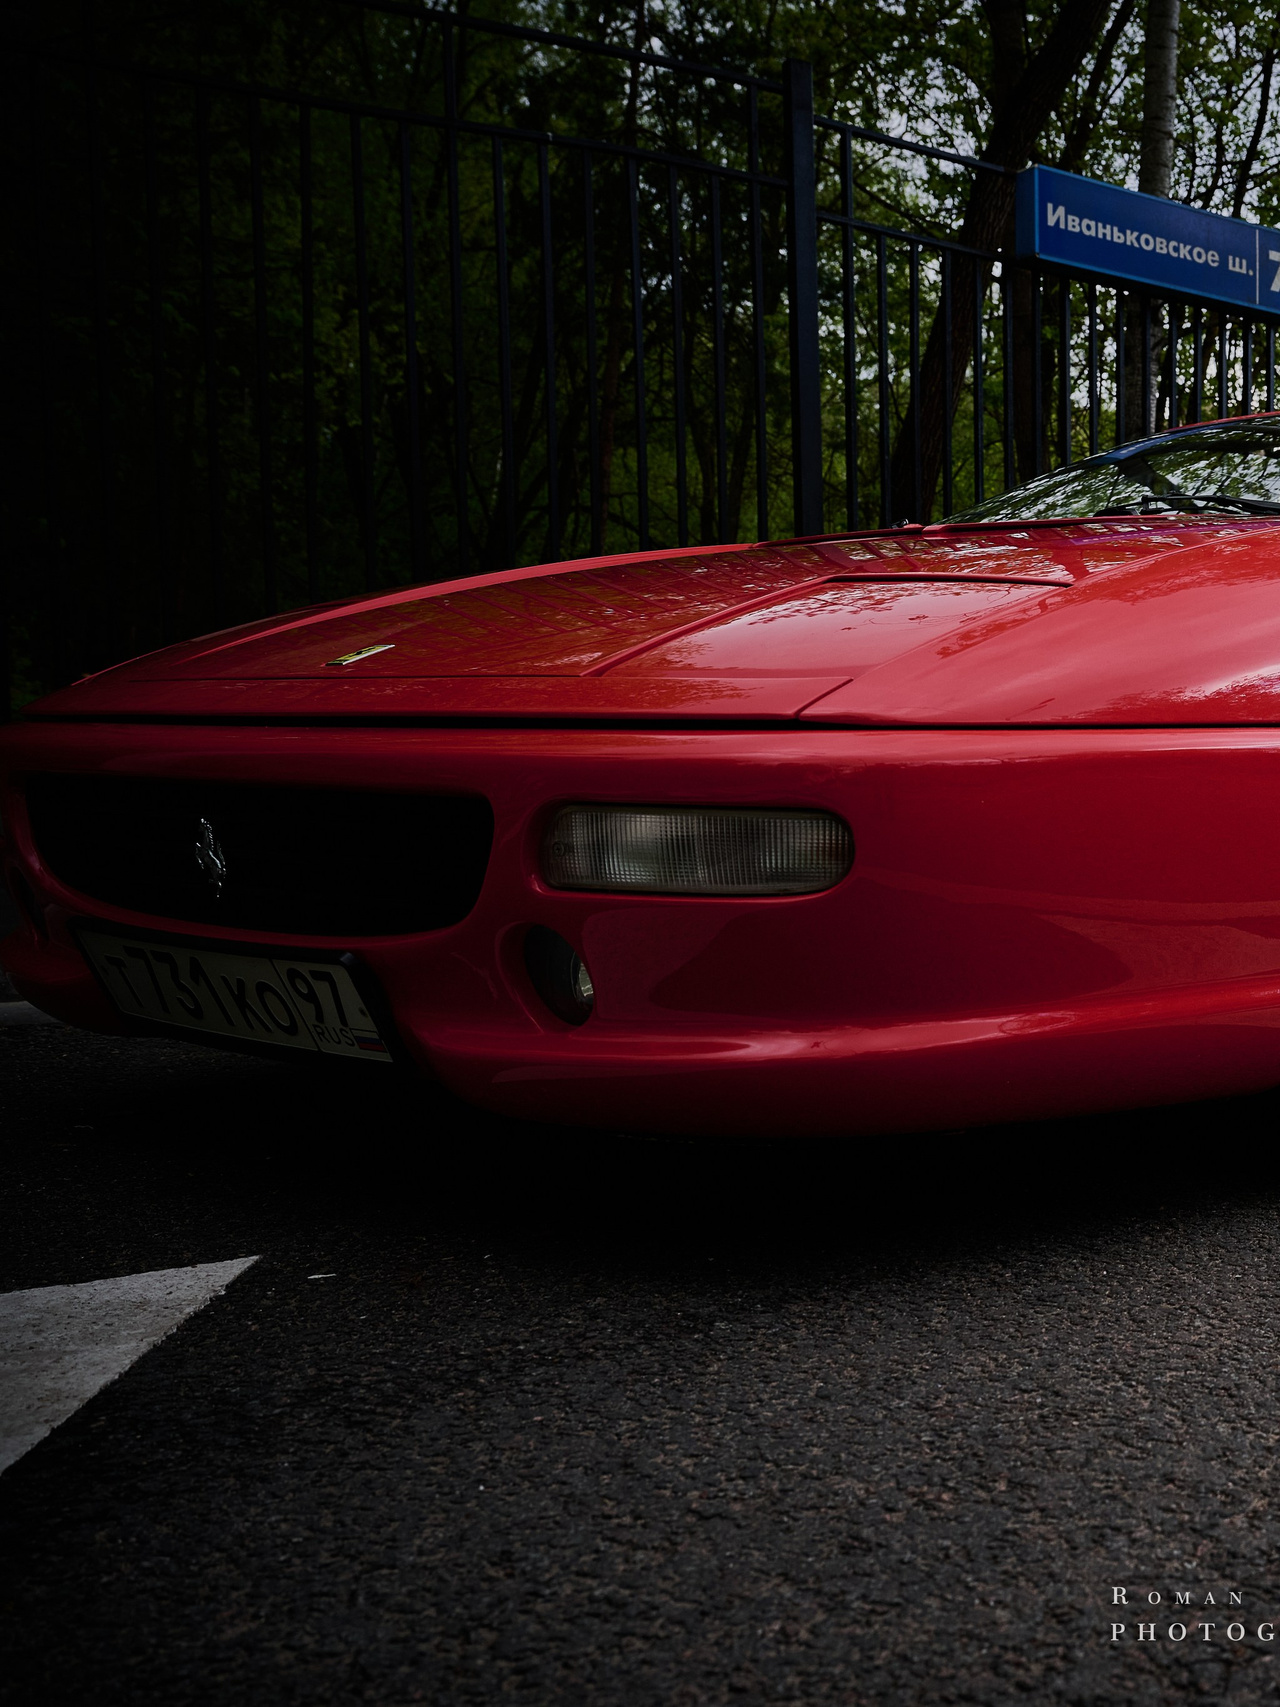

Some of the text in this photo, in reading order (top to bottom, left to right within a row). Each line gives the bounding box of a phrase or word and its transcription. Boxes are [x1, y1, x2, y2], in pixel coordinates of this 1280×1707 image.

[1046, 201, 1220, 267] Иваньковское
[1228, 254, 1254, 277] ш.
[311, 1023, 354, 1047] RUS
